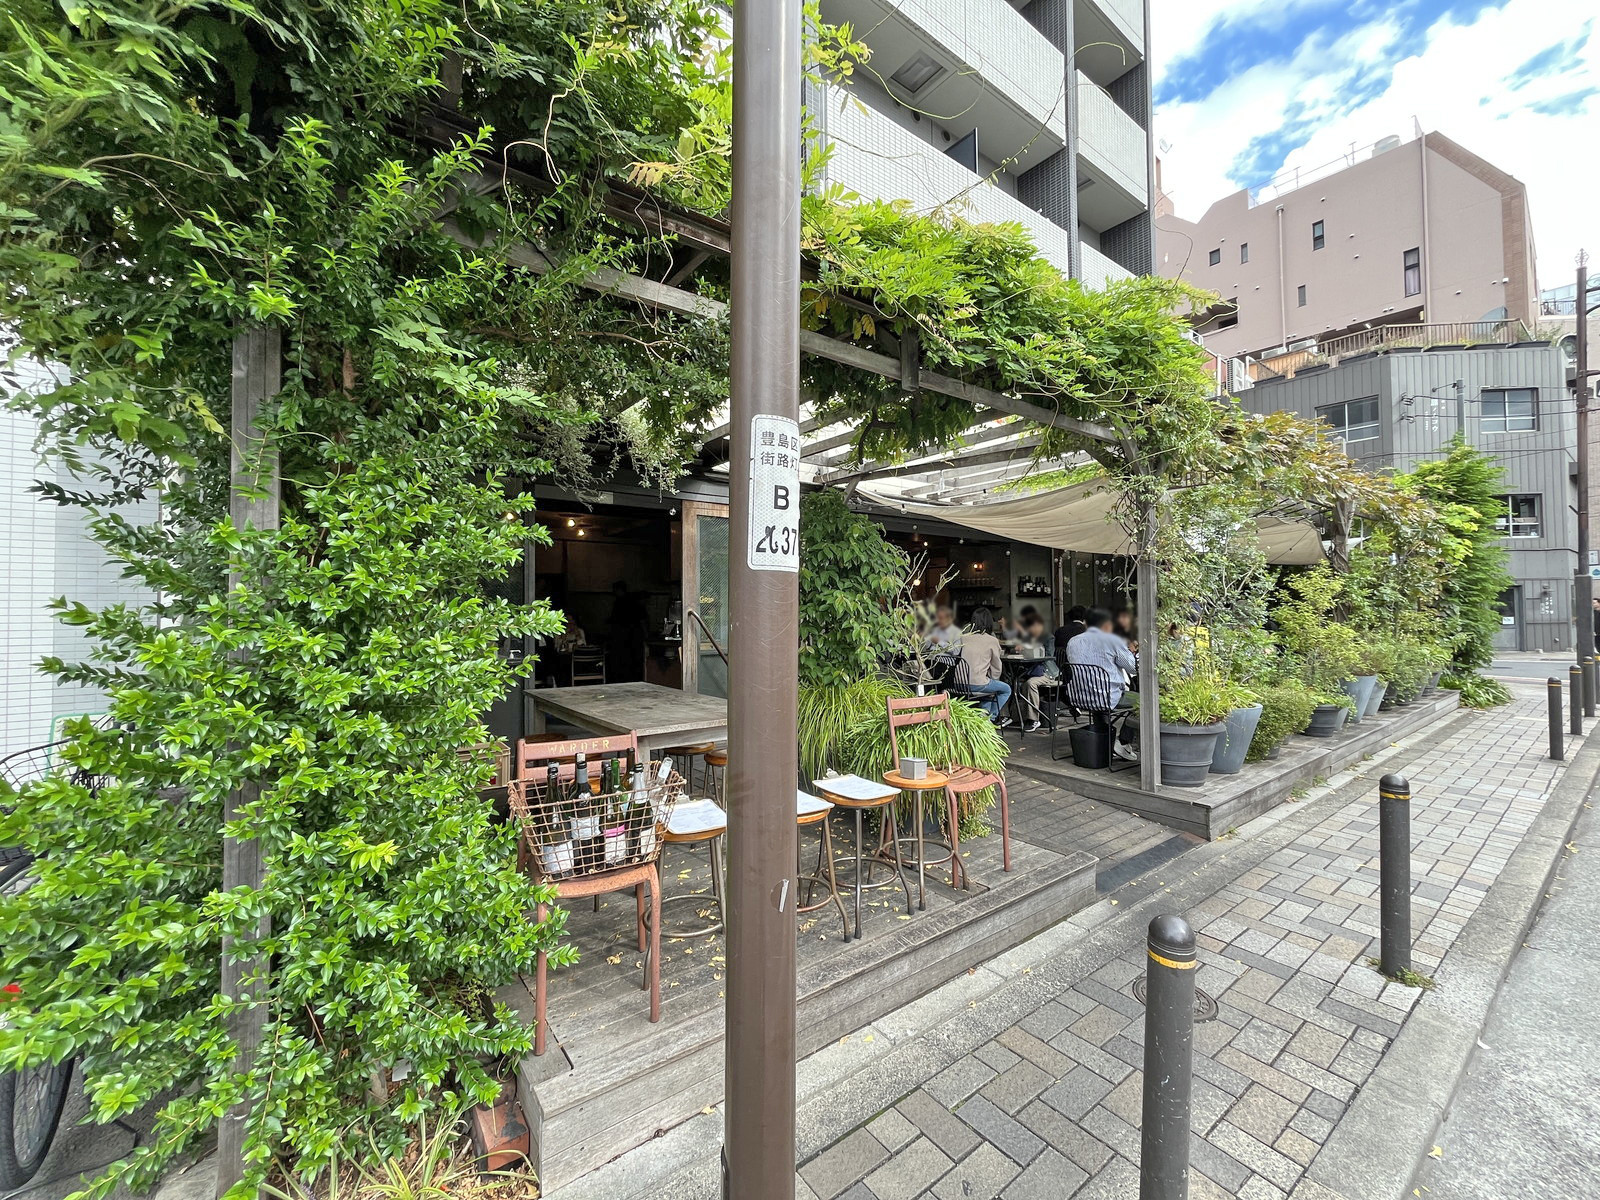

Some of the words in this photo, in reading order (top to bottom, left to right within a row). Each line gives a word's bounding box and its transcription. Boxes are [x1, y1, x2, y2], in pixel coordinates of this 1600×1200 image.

[760, 430, 798, 453] 豊島区
[760, 451, 798, 472] 街路灯
[773, 484, 790, 511] B
